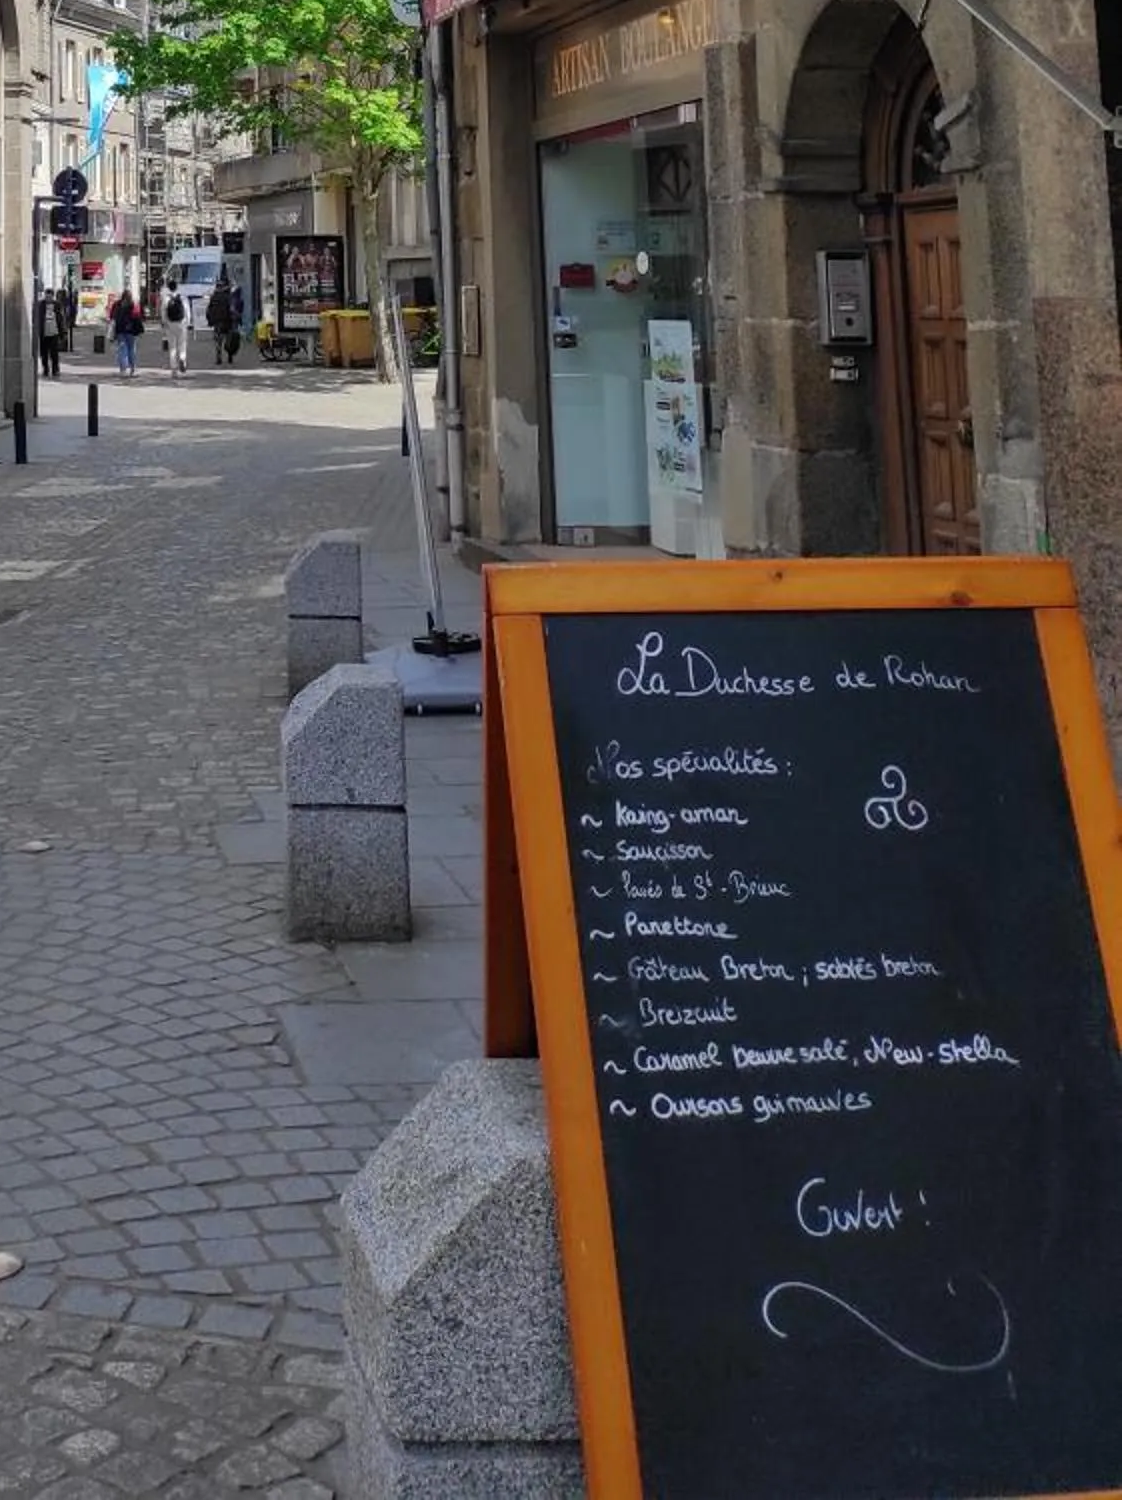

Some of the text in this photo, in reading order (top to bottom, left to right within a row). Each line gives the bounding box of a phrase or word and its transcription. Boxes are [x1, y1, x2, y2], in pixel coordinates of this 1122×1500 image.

[617, 631, 981, 697] La Duchesse de Rohan
[624, 911, 739, 940] Panettone
[720, 955, 795, 981] Breton
[633, 1041, 723, 1073] Caramel
[651, 1092, 743, 1120] Oursons
